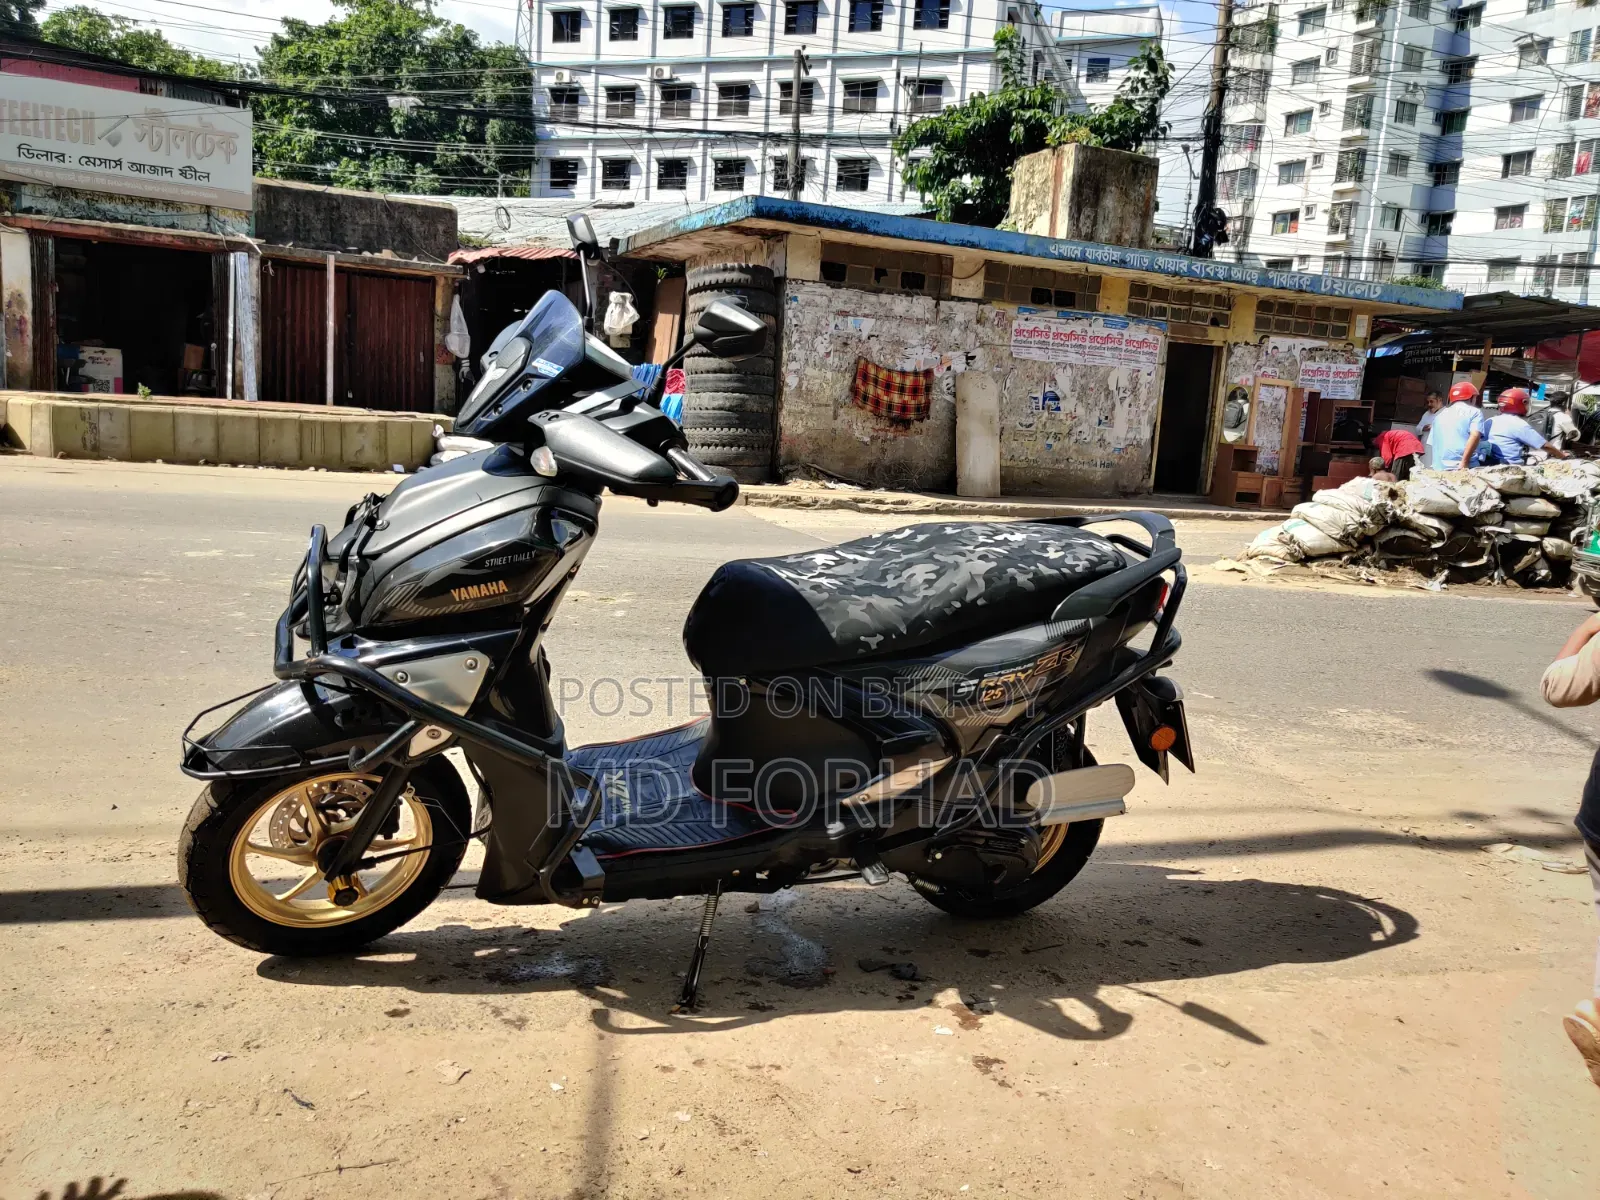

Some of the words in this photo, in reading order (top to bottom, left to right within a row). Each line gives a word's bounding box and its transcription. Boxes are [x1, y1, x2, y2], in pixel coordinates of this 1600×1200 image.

[78, 154, 123, 172] মেসার্স
[127, 161, 174, 179] আজাদ
[1049, 243, 1081, 259] এখানে
[1231, 266, 1259, 284] আছে
[1321, 276, 1383, 298] টয়লেট
[485, 555, 511, 568] STREET
[451, 580, 509, 601] YAMAHA
[1033, 643, 1078, 676] ZR
